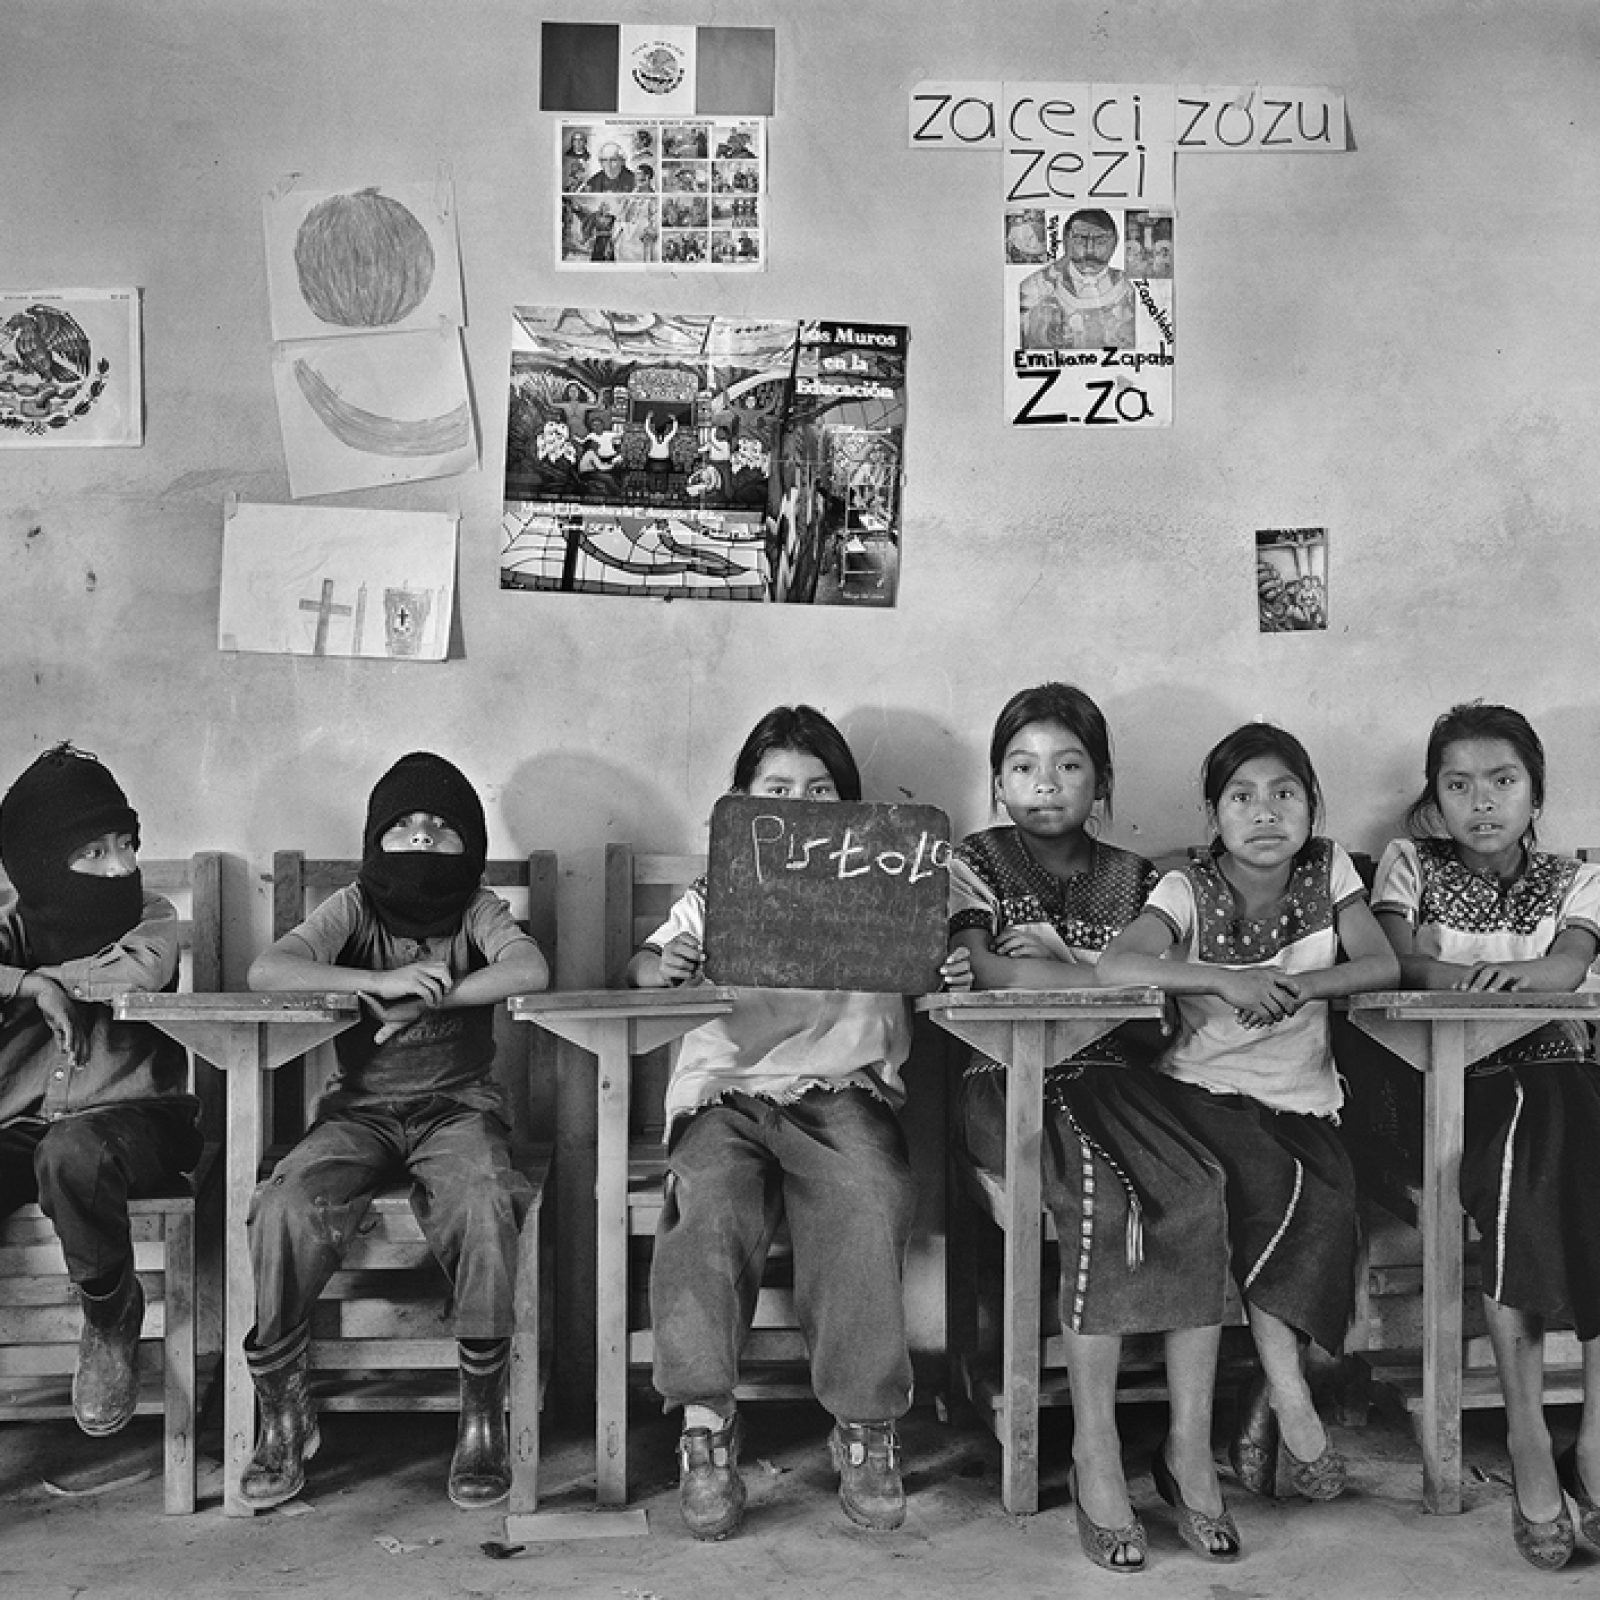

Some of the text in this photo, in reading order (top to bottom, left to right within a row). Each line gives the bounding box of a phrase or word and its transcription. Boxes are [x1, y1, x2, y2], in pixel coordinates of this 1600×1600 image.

[834, 327, 897, 347] Muros
[823, 353, 869, 372] en la
[1014, 341, 1175, 373] Emiliano Zapata
[752, 814, 952, 884] Pistola
